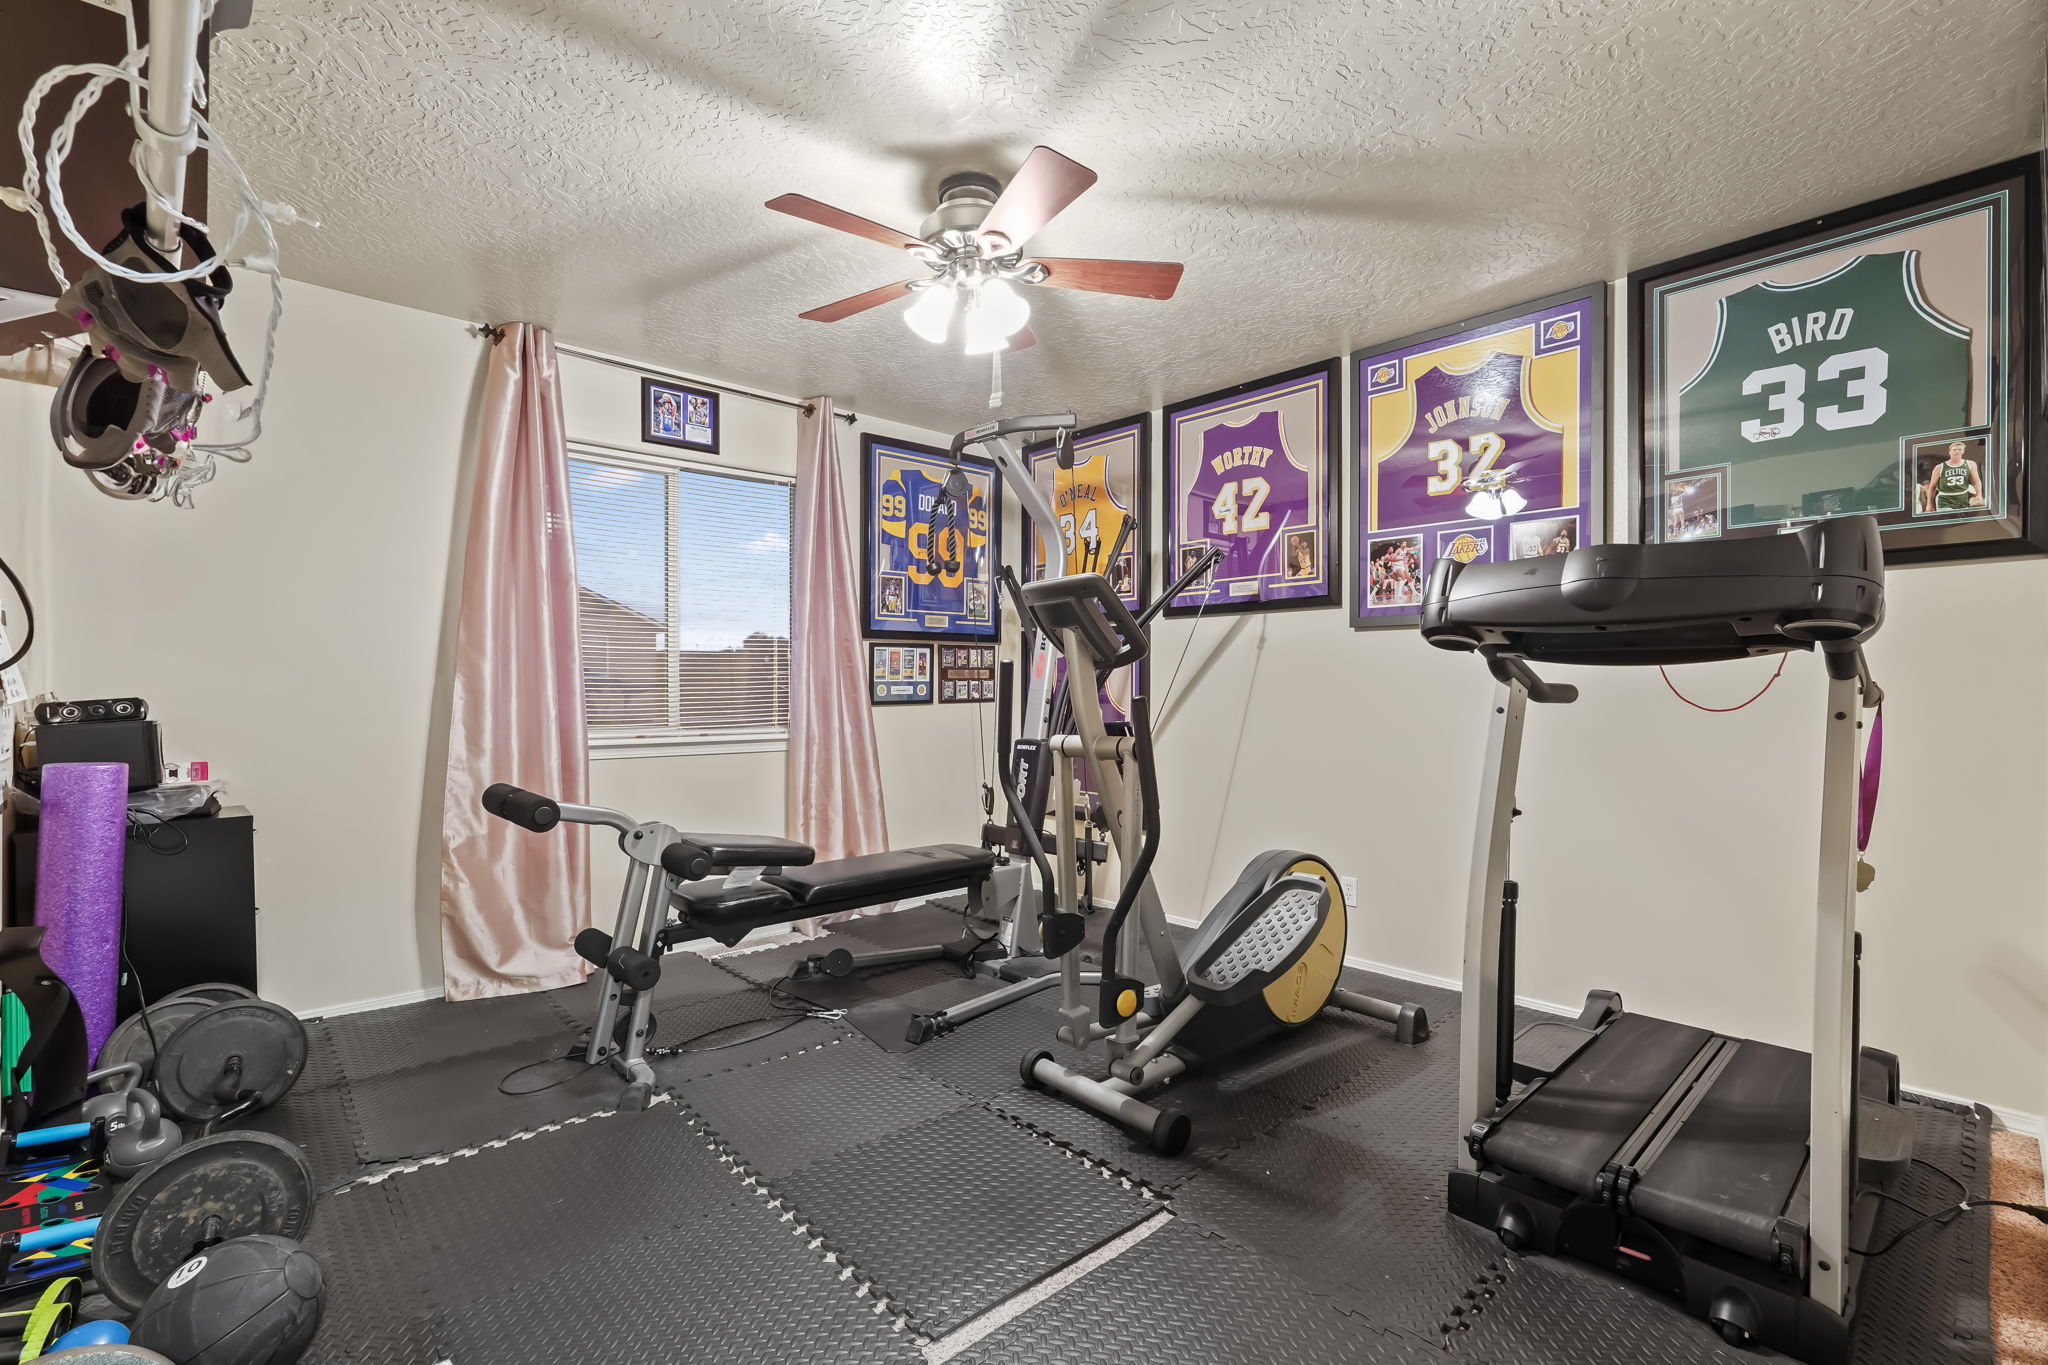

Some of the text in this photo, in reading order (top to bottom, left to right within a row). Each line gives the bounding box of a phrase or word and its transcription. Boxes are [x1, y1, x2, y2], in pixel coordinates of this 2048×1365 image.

[1767, 308, 1855, 354] BIRD
[1741, 346, 1889, 443] 33
[1425, 395, 1511, 434] JOHNSON
[1210, 446, 1274, 476] WORTHY
[1427, 432, 1506, 496] 32
[1945, 468, 1968, 477] CELTICS
[1946, 475, 1965, 486] 33
[882, 494, 906, 518] 99
[1059, 484, 1097, 508] O'NEAL
[1211, 476, 1271, 535] 42
[968, 508, 987, 531] 99
[1059, 508, 1099, 555] 34
[908, 522, 964, 588] 99
[1451, 543, 1485, 556] LAKERS
[175, 1259, 204, 1279] 10
